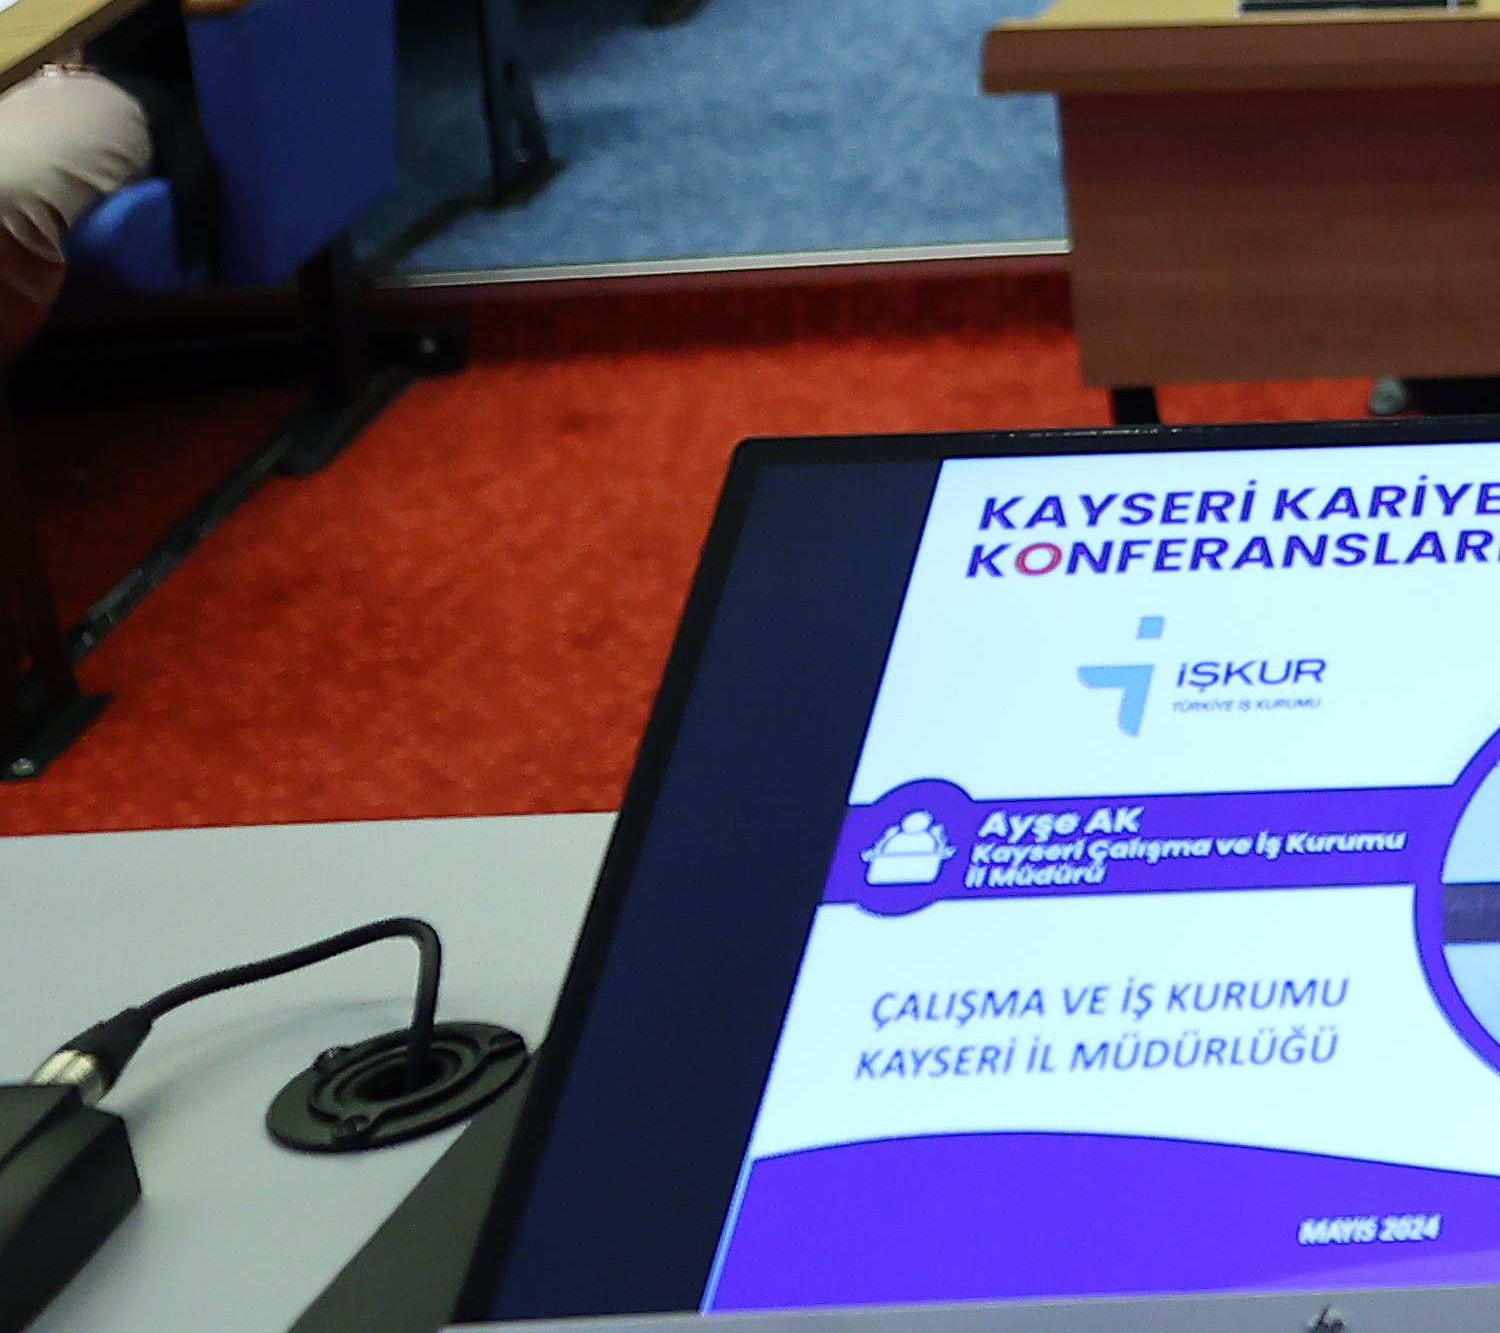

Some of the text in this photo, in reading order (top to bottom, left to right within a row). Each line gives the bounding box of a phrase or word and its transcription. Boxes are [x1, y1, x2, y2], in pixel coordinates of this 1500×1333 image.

[978, 480, 1257, 530] KAYSERİ
[977, 806, 1144, 844] Ayşe AK
[970, 836, 1085, 866] Kayseri
[1089, 835, 1214, 866] Çalışma
[1215, 837, 1253, 857] ve
[1285, 830, 1408, 855] Kurumu
[987, 861, 1107, 888] Müdürü
[870, 975, 1351, 1032] ÇALIŞMA VE İŞ KURUMU
[855, 1023, 1340, 1081] KAYSERİ İL MÜDÜRLÜĞÜ
